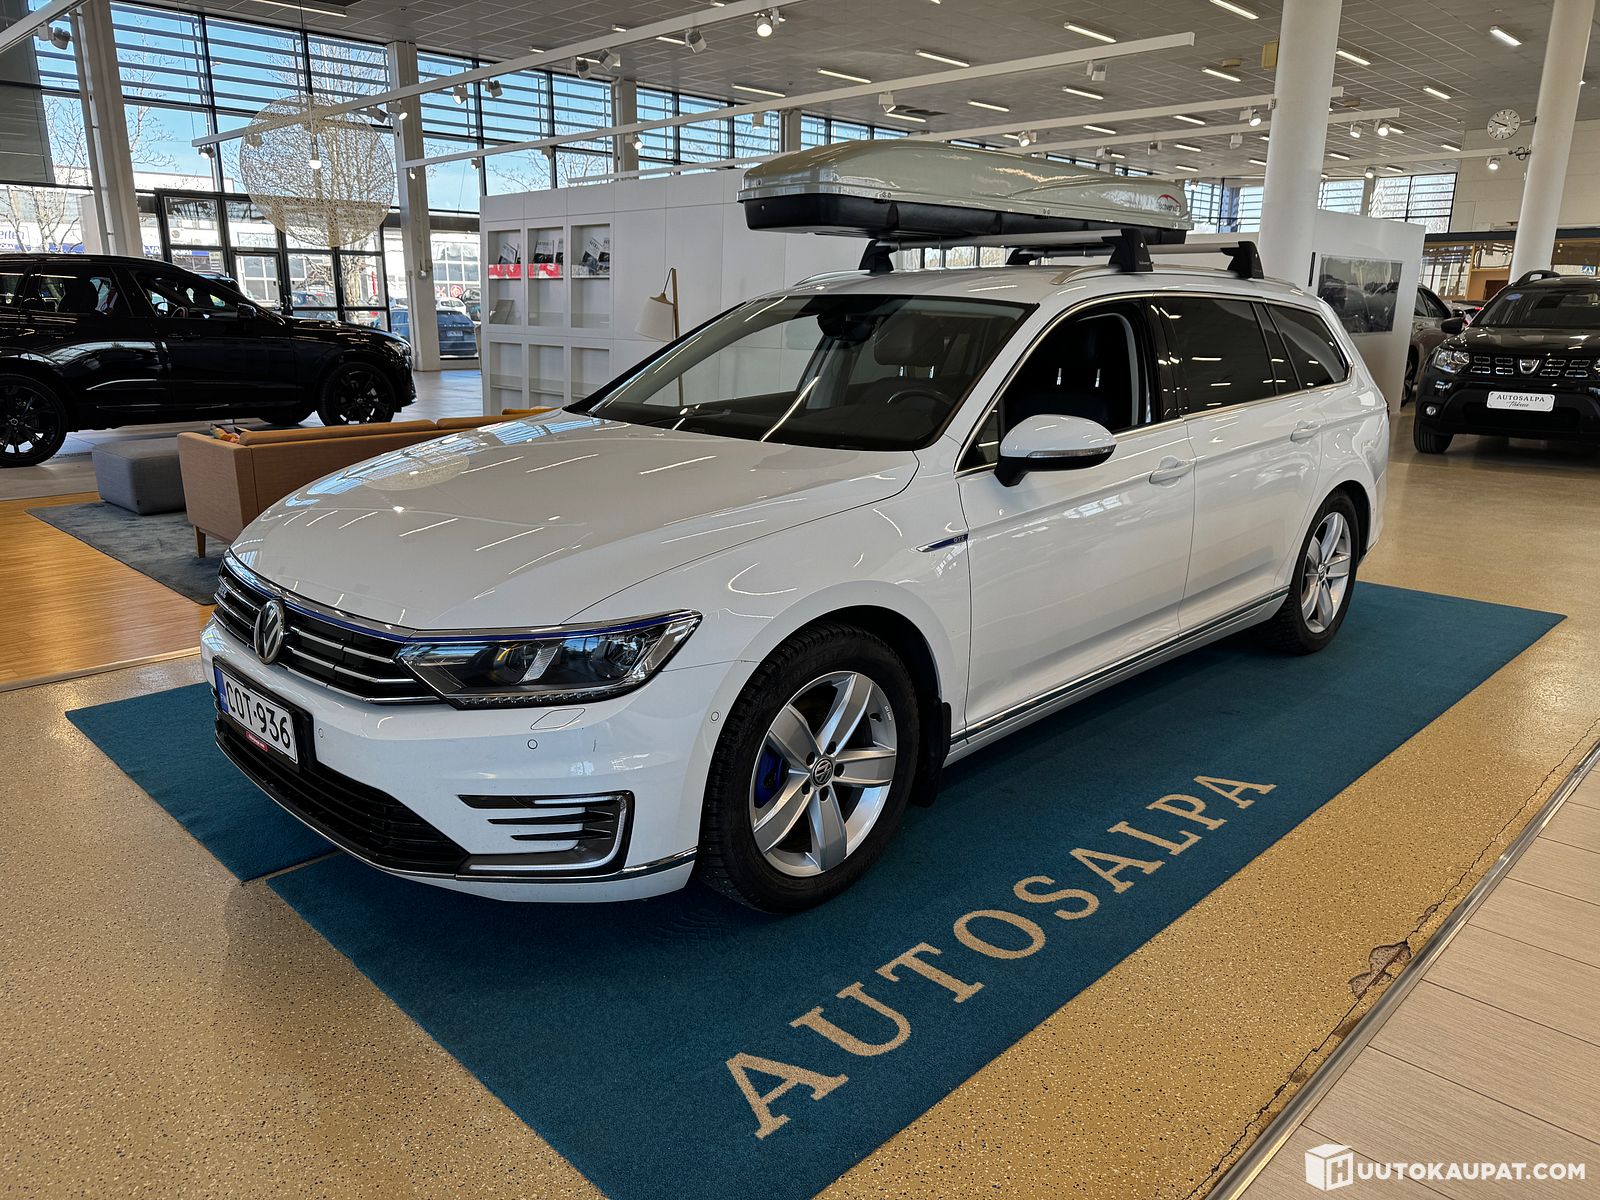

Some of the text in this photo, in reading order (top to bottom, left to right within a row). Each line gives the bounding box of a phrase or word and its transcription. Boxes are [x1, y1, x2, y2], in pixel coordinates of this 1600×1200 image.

[1496, 394, 1545, 402] AUTOSALPA
[226, 680, 291, 749] COT-936
[724, 774, 1278, 1140] AUTOSALPA
